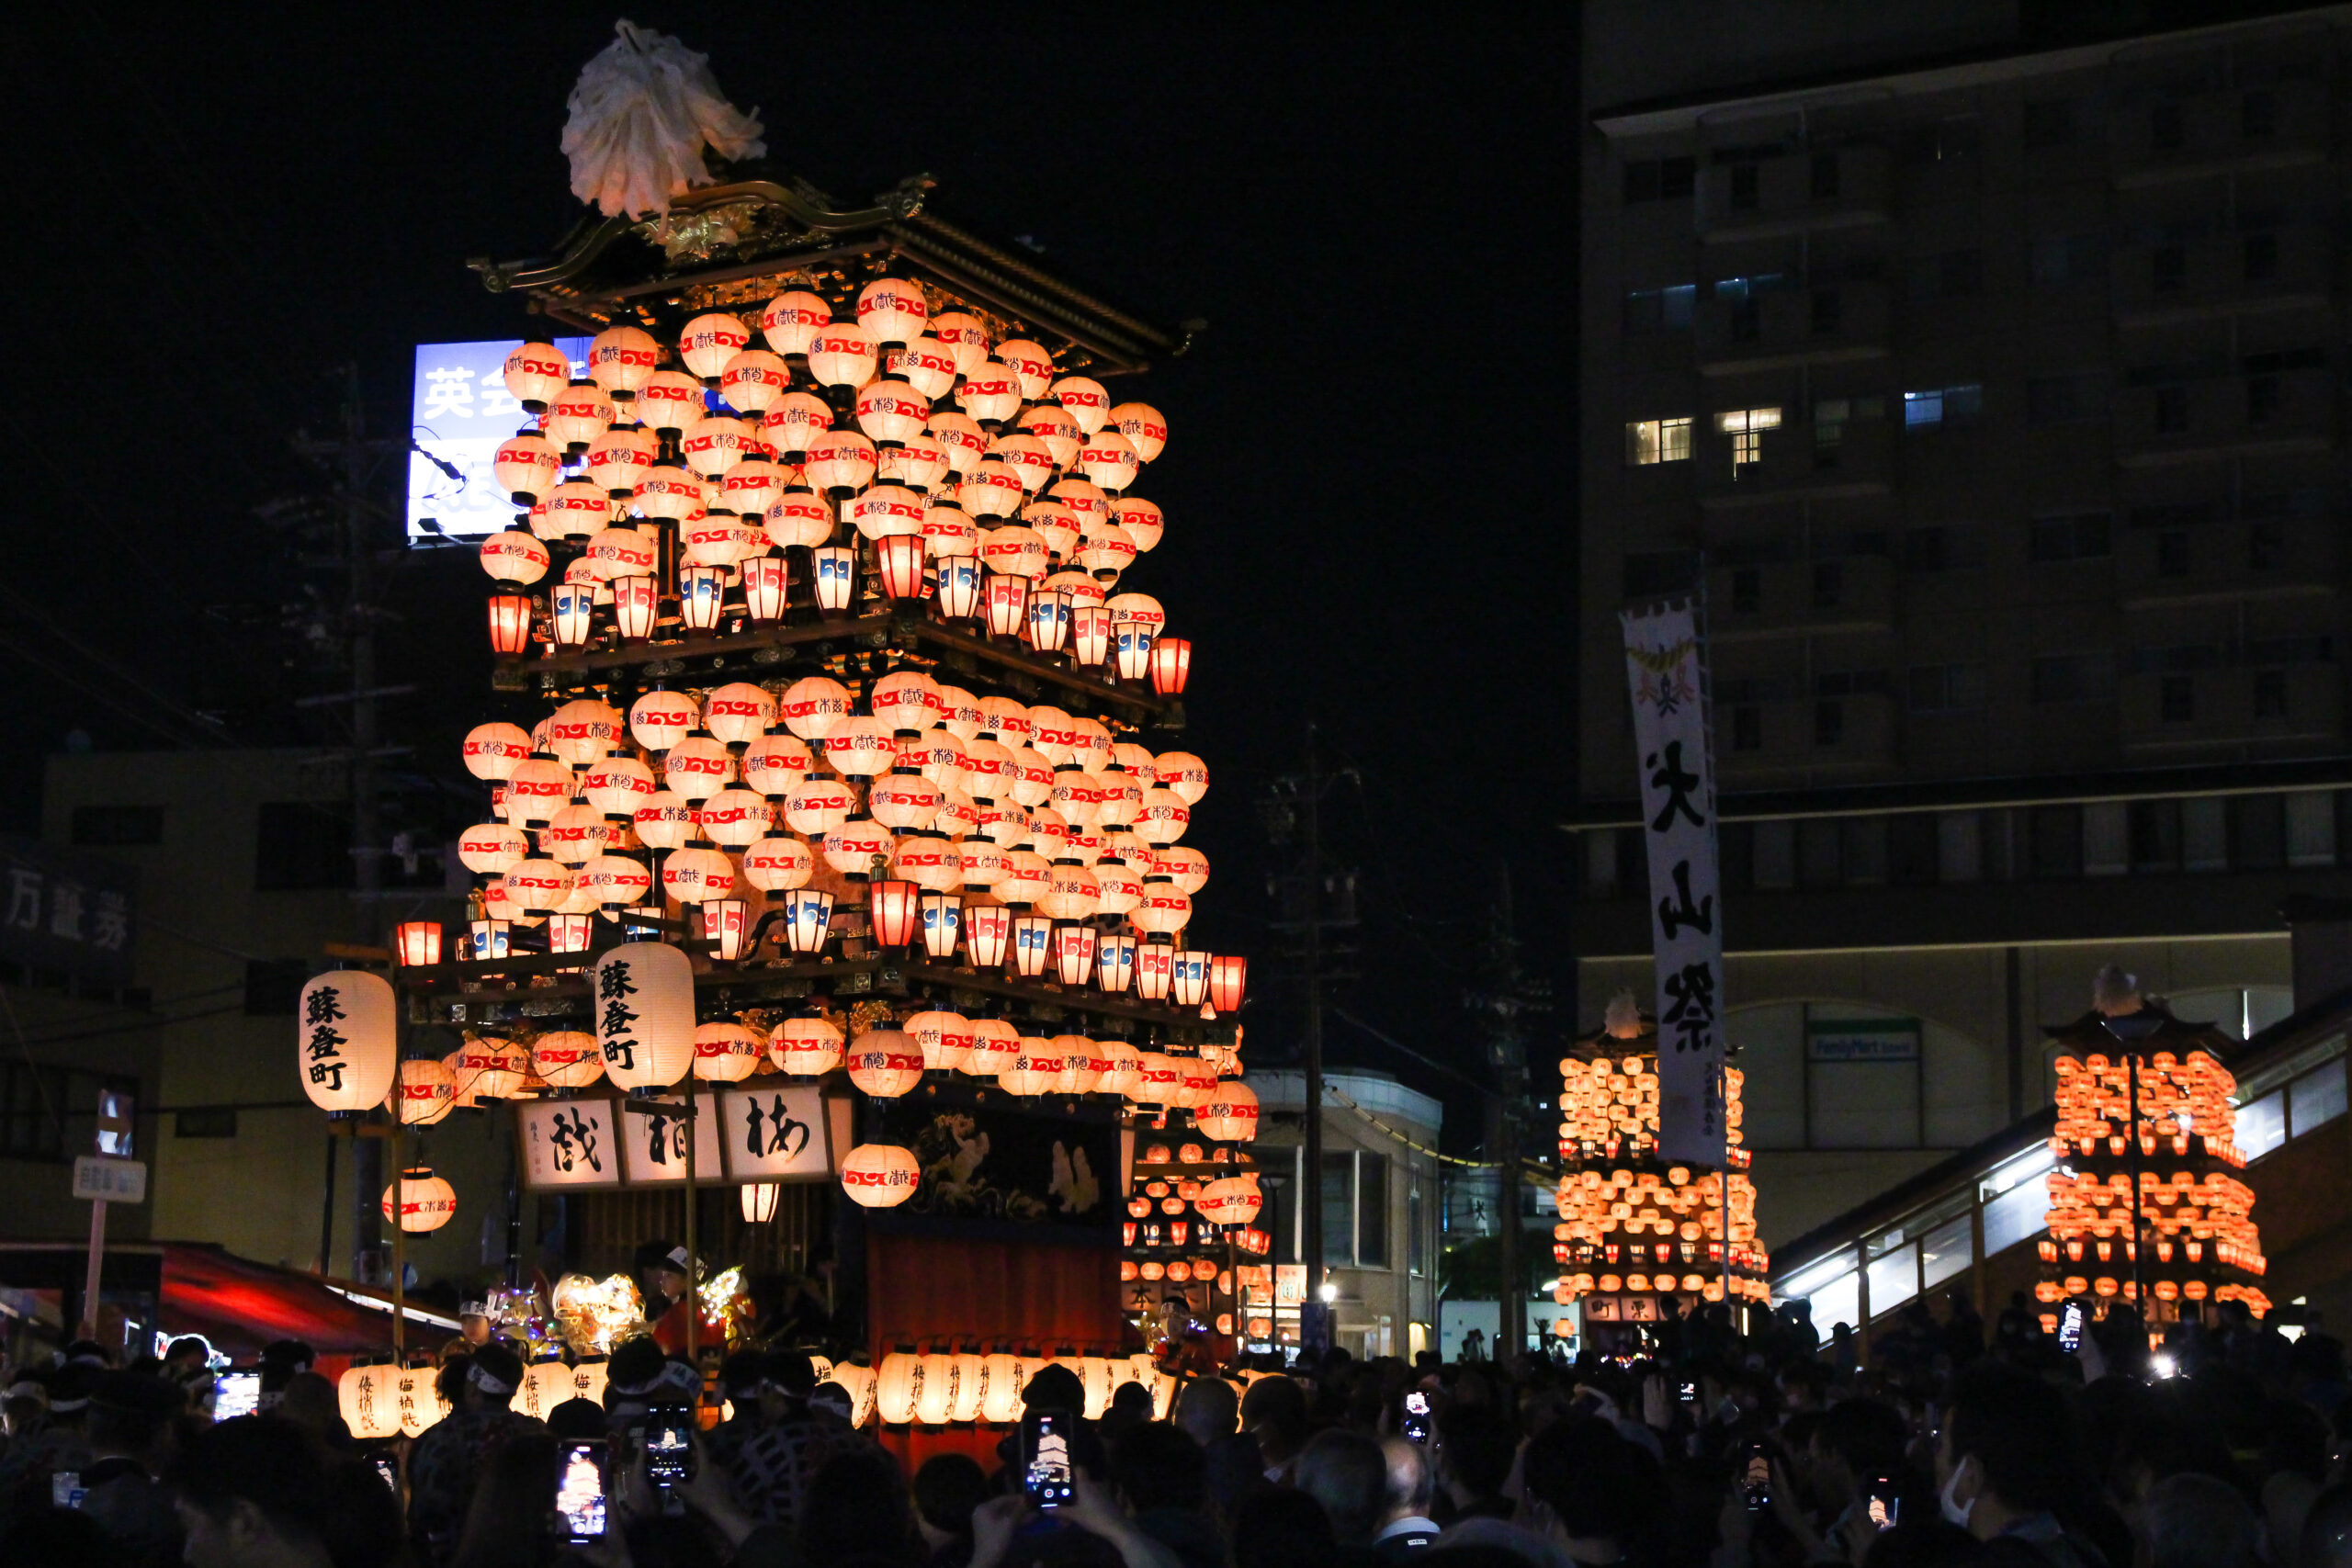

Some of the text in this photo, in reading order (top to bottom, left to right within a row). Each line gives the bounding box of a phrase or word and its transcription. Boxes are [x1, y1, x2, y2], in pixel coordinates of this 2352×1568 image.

[306, 986, 347, 1091] 蘇登町
[599, 960, 639, 1070] 蘇登町
[526, 1374, 539, 1417] 梅梢
